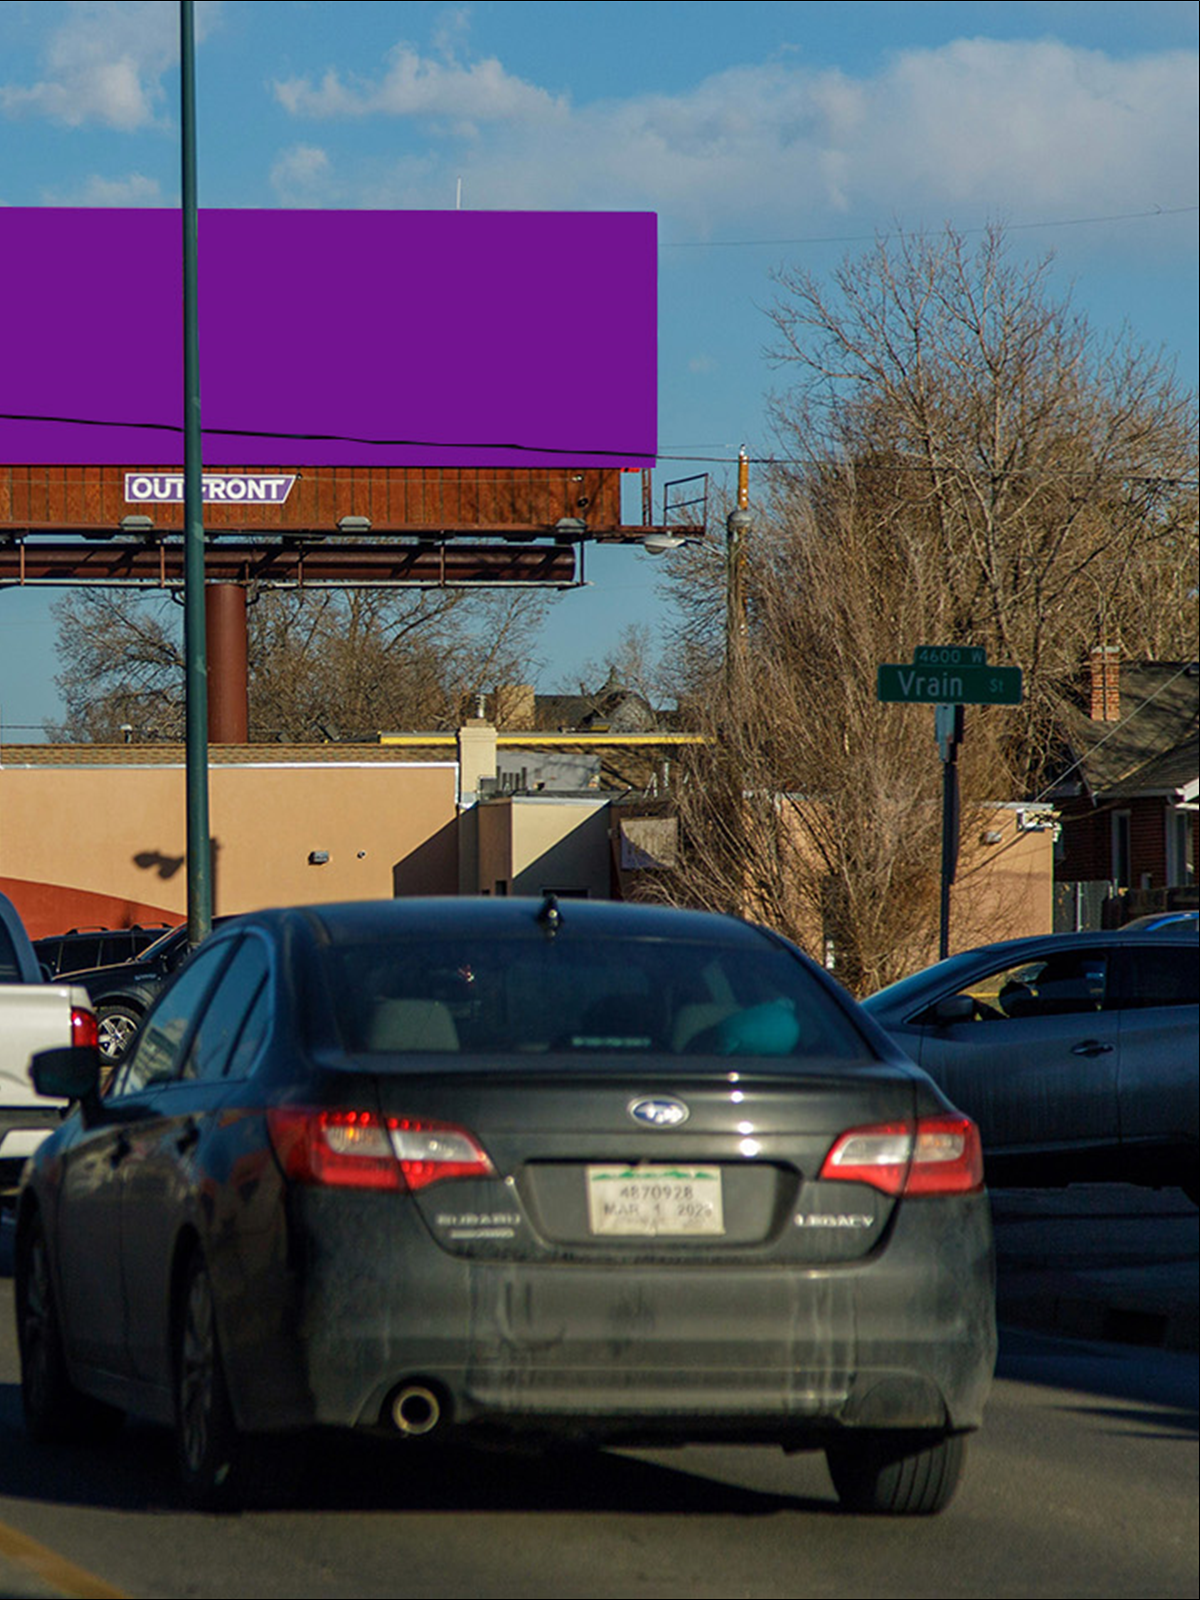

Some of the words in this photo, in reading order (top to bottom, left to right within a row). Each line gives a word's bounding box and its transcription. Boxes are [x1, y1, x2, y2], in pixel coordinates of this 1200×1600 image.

[132, 477, 285, 499] OUTRONT
[919, 650, 961, 663] 4600
[971, 650, 983, 663] W
[898, 670, 963, 697] Vrain
[989, 678, 1004, 693] St
[620, 1185, 694, 1200] 4870928
[603, 1203, 640, 1216] MAR
